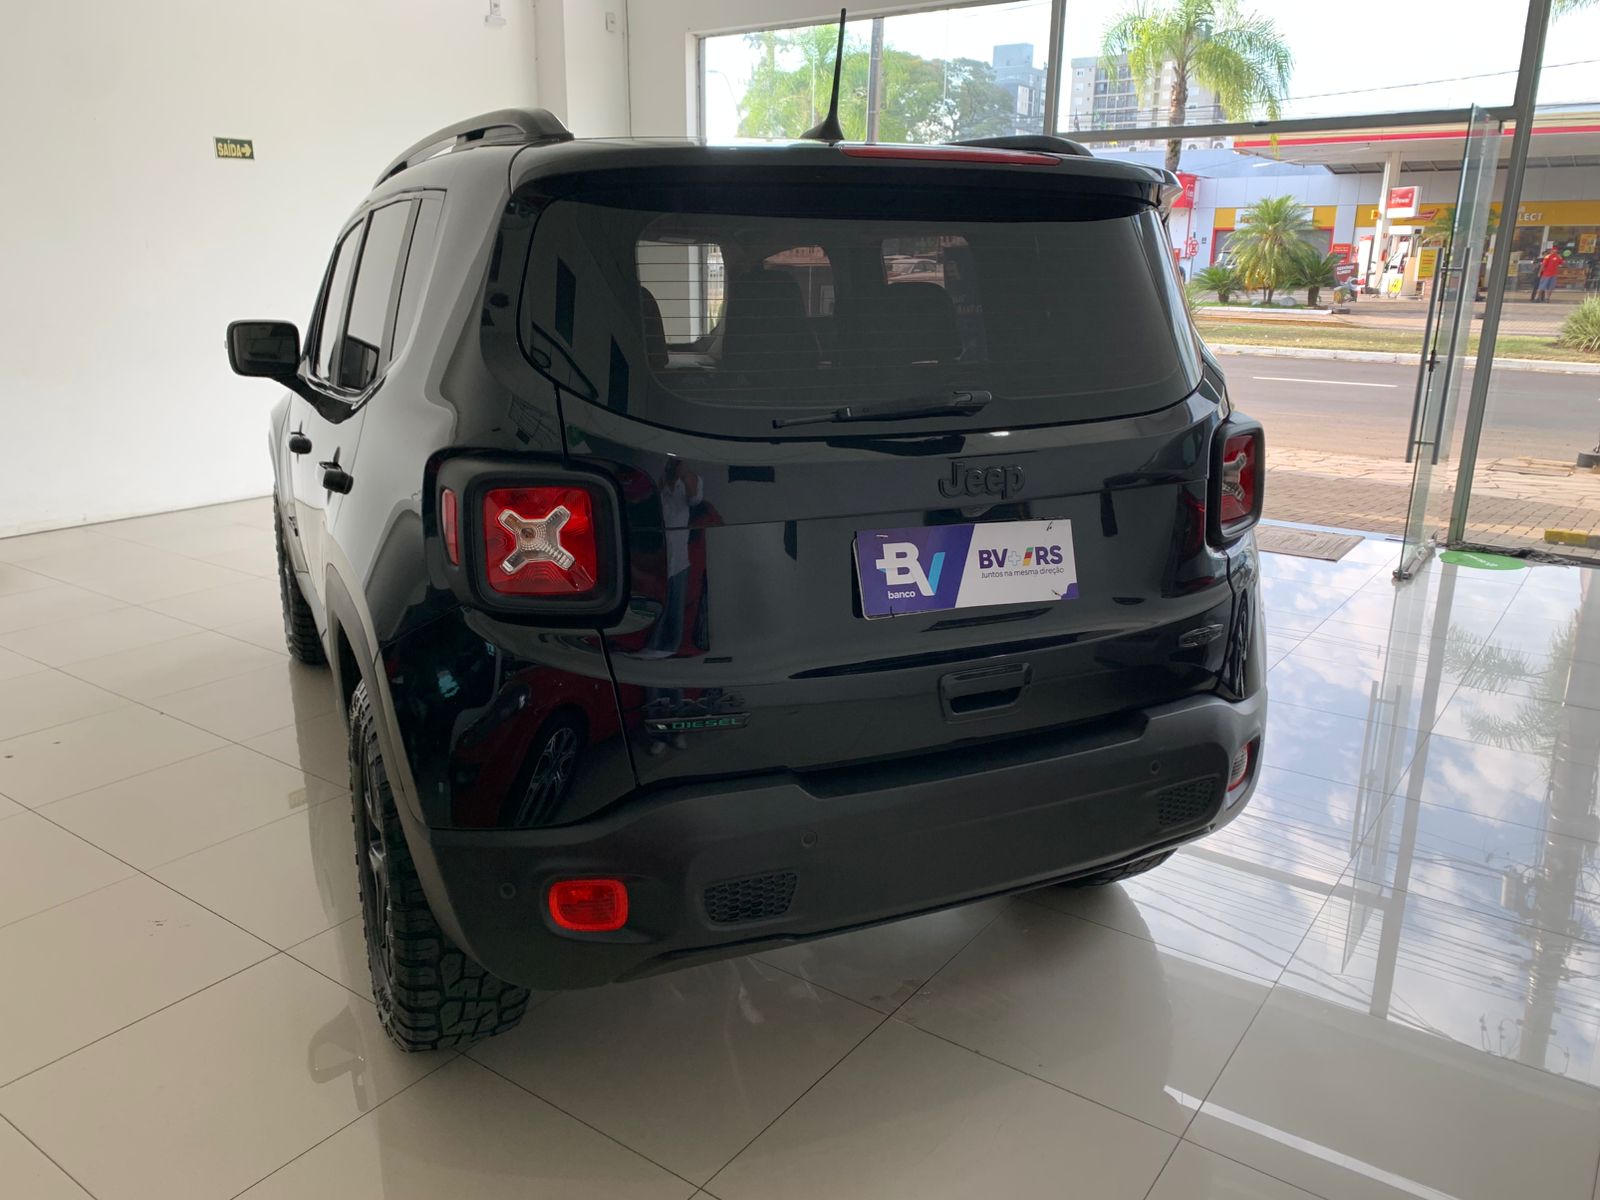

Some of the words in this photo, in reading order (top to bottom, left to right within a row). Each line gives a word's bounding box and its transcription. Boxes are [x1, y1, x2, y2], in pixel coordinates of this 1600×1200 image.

[217, 140, 242, 157] SAÍDA
[1518, 212, 1543, 221] LECT
[938, 461, 1025, 500] Jeep
[876, 542, 946, 597] BV
[981, 571, 1003, 579] Juntos
[1014, 568, 1039, 576] mesma
[1040, 566, 1064, 575] direção
[887, 590, 916, 600] banco
[672, 717, 742, 730] DIESEL
